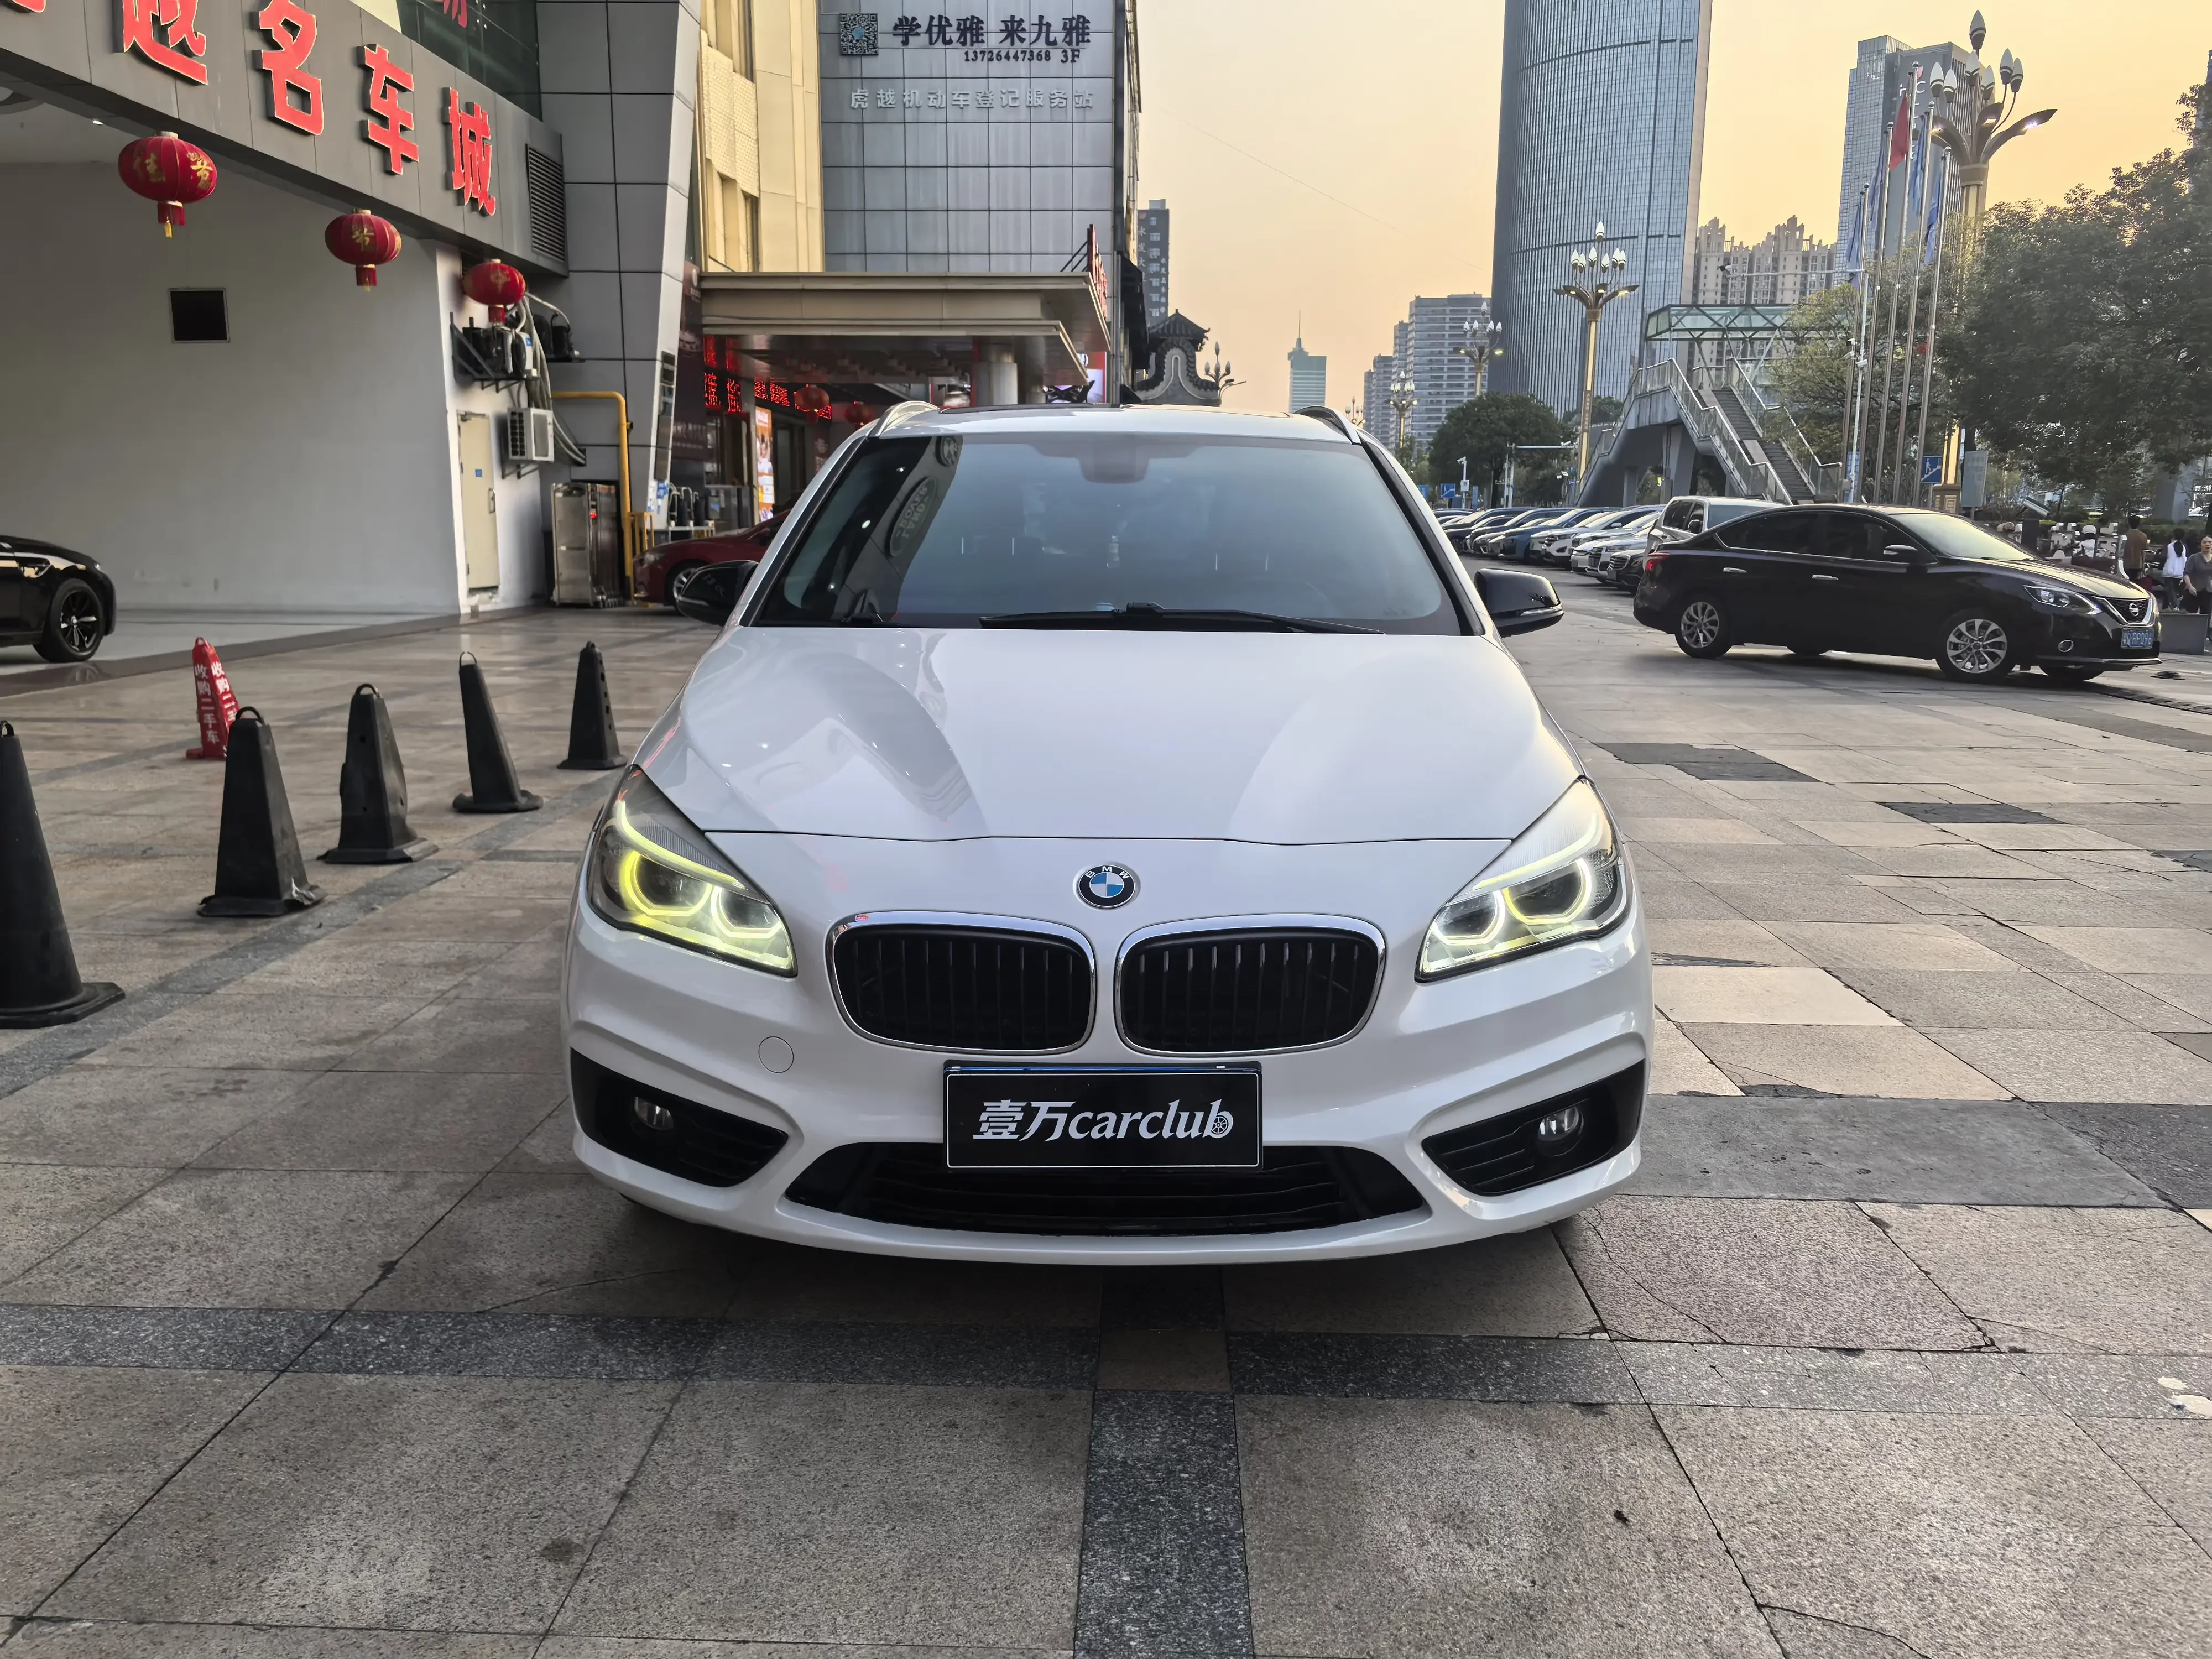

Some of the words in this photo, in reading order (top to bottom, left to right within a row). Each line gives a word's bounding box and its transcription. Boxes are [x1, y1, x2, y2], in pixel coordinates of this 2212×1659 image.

[893, 14, 985, 46] 学优雅
[999, 14, 1091, 46] 来九雅
[964, 50, 1051, 62] 13726447368
[1060, 49, 1081, 63] 3F
[0, 0, 495, 216] 越名车城
[851, 88, 1093, 109] 虎越机动车登记服务站
[195, 663, 220, 744] 收购二手车
[1084, 865, 1130, 879] BMW
